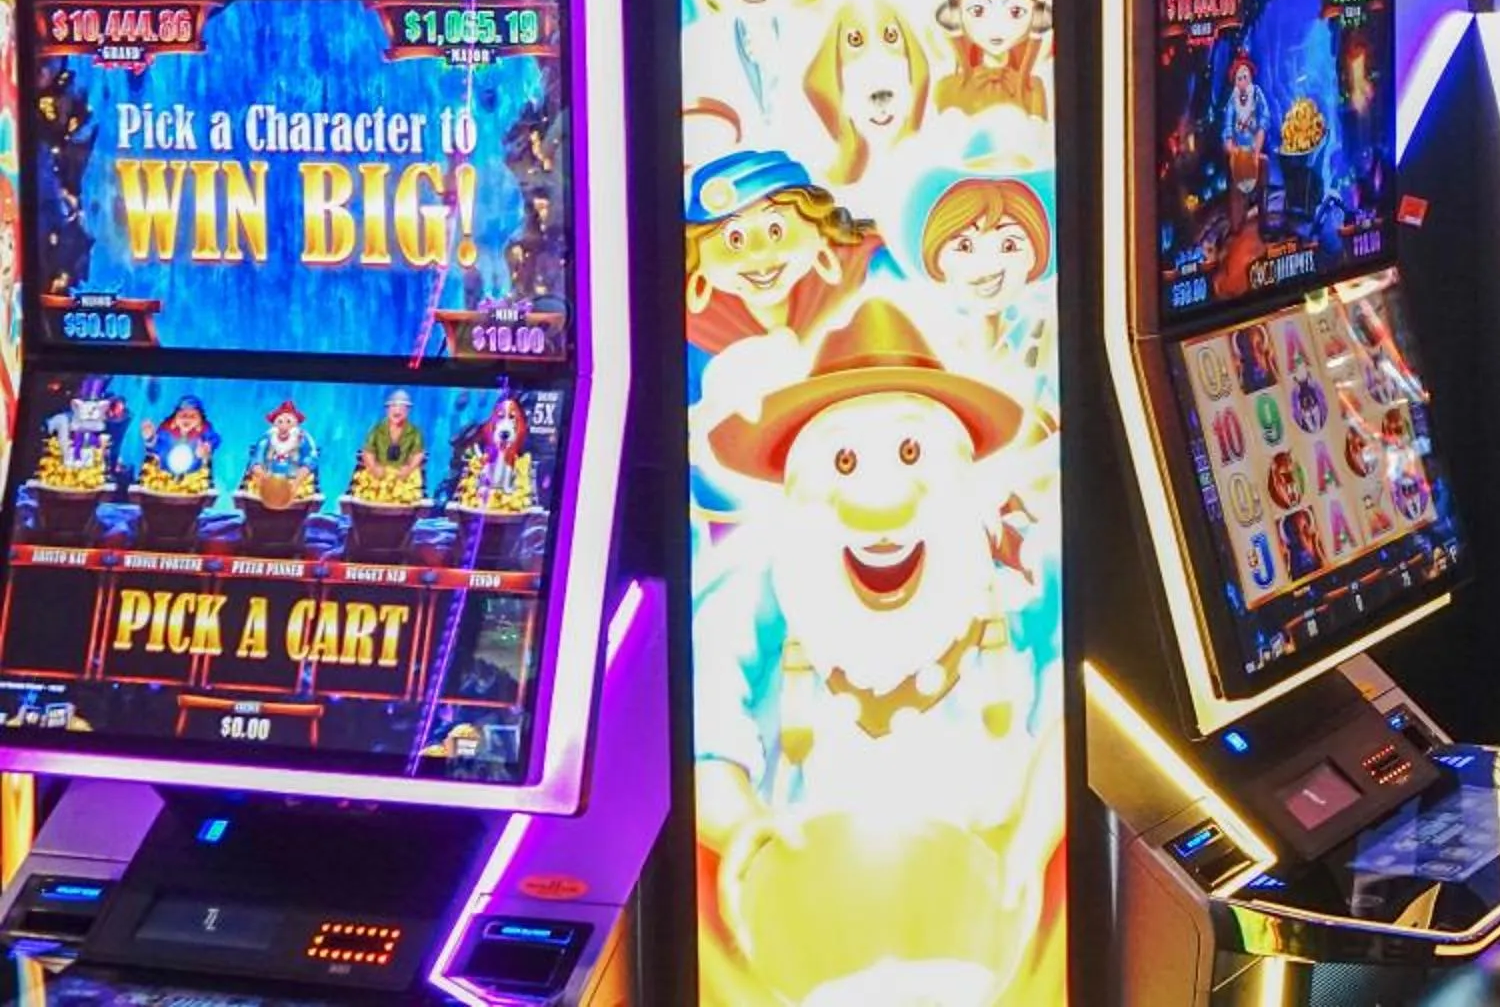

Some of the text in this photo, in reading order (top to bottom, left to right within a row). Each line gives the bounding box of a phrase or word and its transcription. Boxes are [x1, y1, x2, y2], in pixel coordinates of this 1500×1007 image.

[116, 102, 478, 155] Pick a Character to
[114, 157, 480, 268] WIN BIG!
[532, 402, 557, 425] 5X
[113, 589, 411, 667] PICK A CART
[220, 715, 272, 741] $0.00
